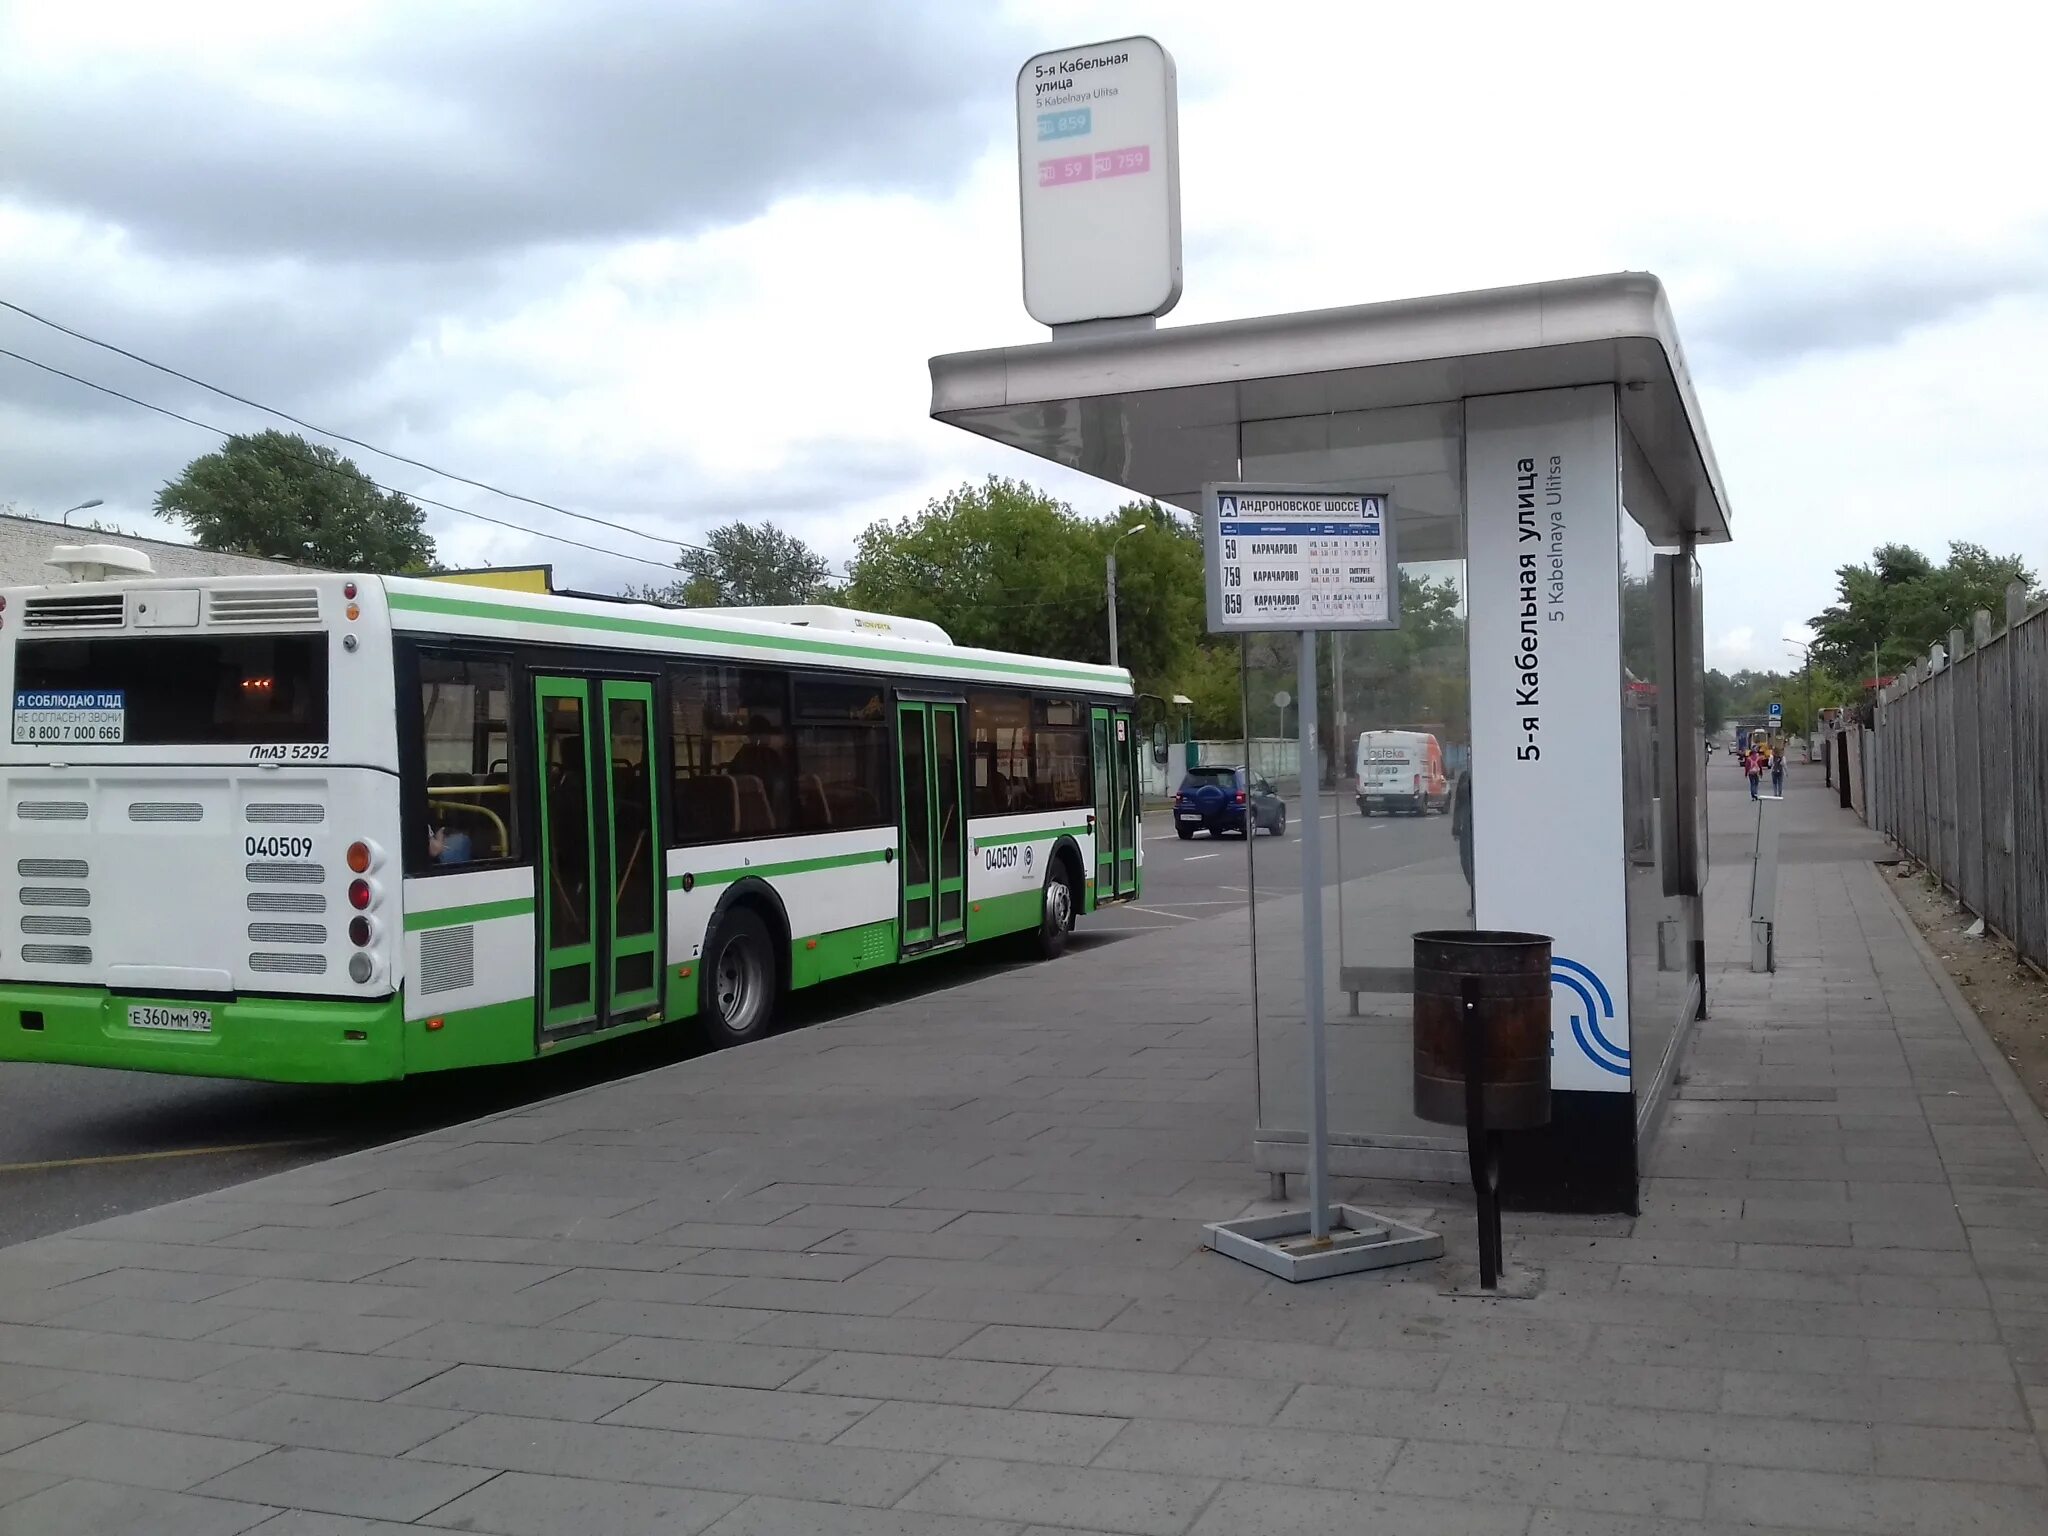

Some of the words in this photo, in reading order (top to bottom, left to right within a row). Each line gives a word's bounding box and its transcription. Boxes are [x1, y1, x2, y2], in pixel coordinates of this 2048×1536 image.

[1035, 65, 1056, 78] 5-я
[1059, 53, 1129, 73] Кабельная
[1035, 77, 1073, 96] улица
[1036, 99, 1043, 108] 5
[1044, 92, 1091, 107] Kabelnaya
[1093, 87, 1119, 99] Ulitsa
[1057, 114, 1087, 130] 859
[1064, 163, 1082, 177] 59
[1117, 152, 1144, 169] 759
[1545, 455, 1562, 506] Ulitsa
[1240, 500, 1322, 512] АНДРОНОВСКОЕ
[1324, 501, 1360, 512] ШОССЕ
[1517, 457, 1541, 543] улица
[1225, 539, 1237, 560] 59
[1251, 543, 1298, 555] КАРАЧАРОВО
[1547, 511, 1567, 604] Kabelnaya
[1224, 566, 1241, 588] 759
[1253, 570, 1299, 583] КАРАЧАРОВО
[1224, 594, 1242, 614] 859
[1254, 594, 1300, 606] КАРАЧАРОВО
[1549, 610, 1564, 622] 5
[1514, 553, 1540, 706] Кабельная
[17, 695, 25, 707] Я
[27, 695, 95, 708] СОБЛЮДАЮ
[97, 695, 121, 708] ПДД
[17, 713, 29, 722] НЕ
[31, 712, 86, 723] СОГЛАСЕН?
[88, 712, 122, 723] ЗВОНИ
[28, 726, 36, 739] 8
[39, 726, 60, 739] 800
[63, 726, 71, 739] 7
[74, 726, 95, 739] 000
[98, 726, 120, 739] 666
[1517, 715, 1540, 761] 5-я
[291, 745, 329, 759] 5292
[245, 836, 313, 858] 040509
[985, 845, 1018, 871] 040509
[192, 1010, 207, 1024] 99
